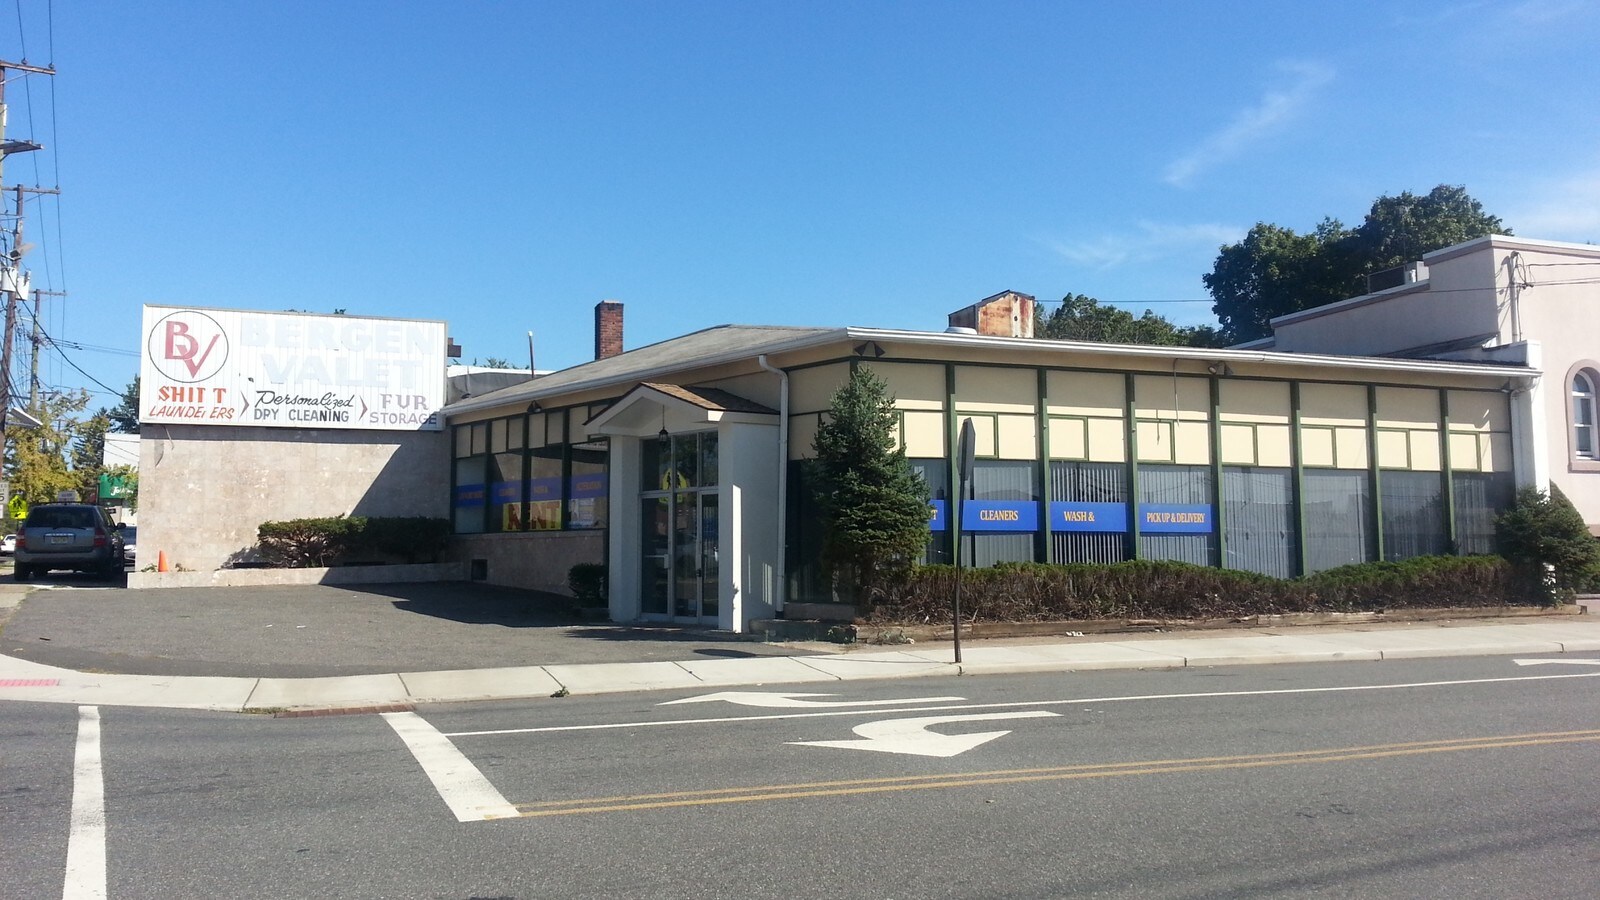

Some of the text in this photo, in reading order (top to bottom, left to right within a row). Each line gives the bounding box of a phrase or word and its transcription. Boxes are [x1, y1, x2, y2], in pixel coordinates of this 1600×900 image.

[240, 317, 436, 355] BERGEN
[261, 353, 423, 389] VALET
[255, 390, 355, 410] Personalized
[380, 393, 429, 411] FUR
[149, 405, 235, 420] LAUNDEERS
[288, 408, 350, 422] CLEANING
[369, 411, 437, 425] STORAGE
[507, 501, 560, 530] RNT
[980, 509, 1019, 521] CLEANERS
[1063, 511, 1095, 522] WASH &
[1146, 512, 1206, 523] PICK UP & DELIVERY
